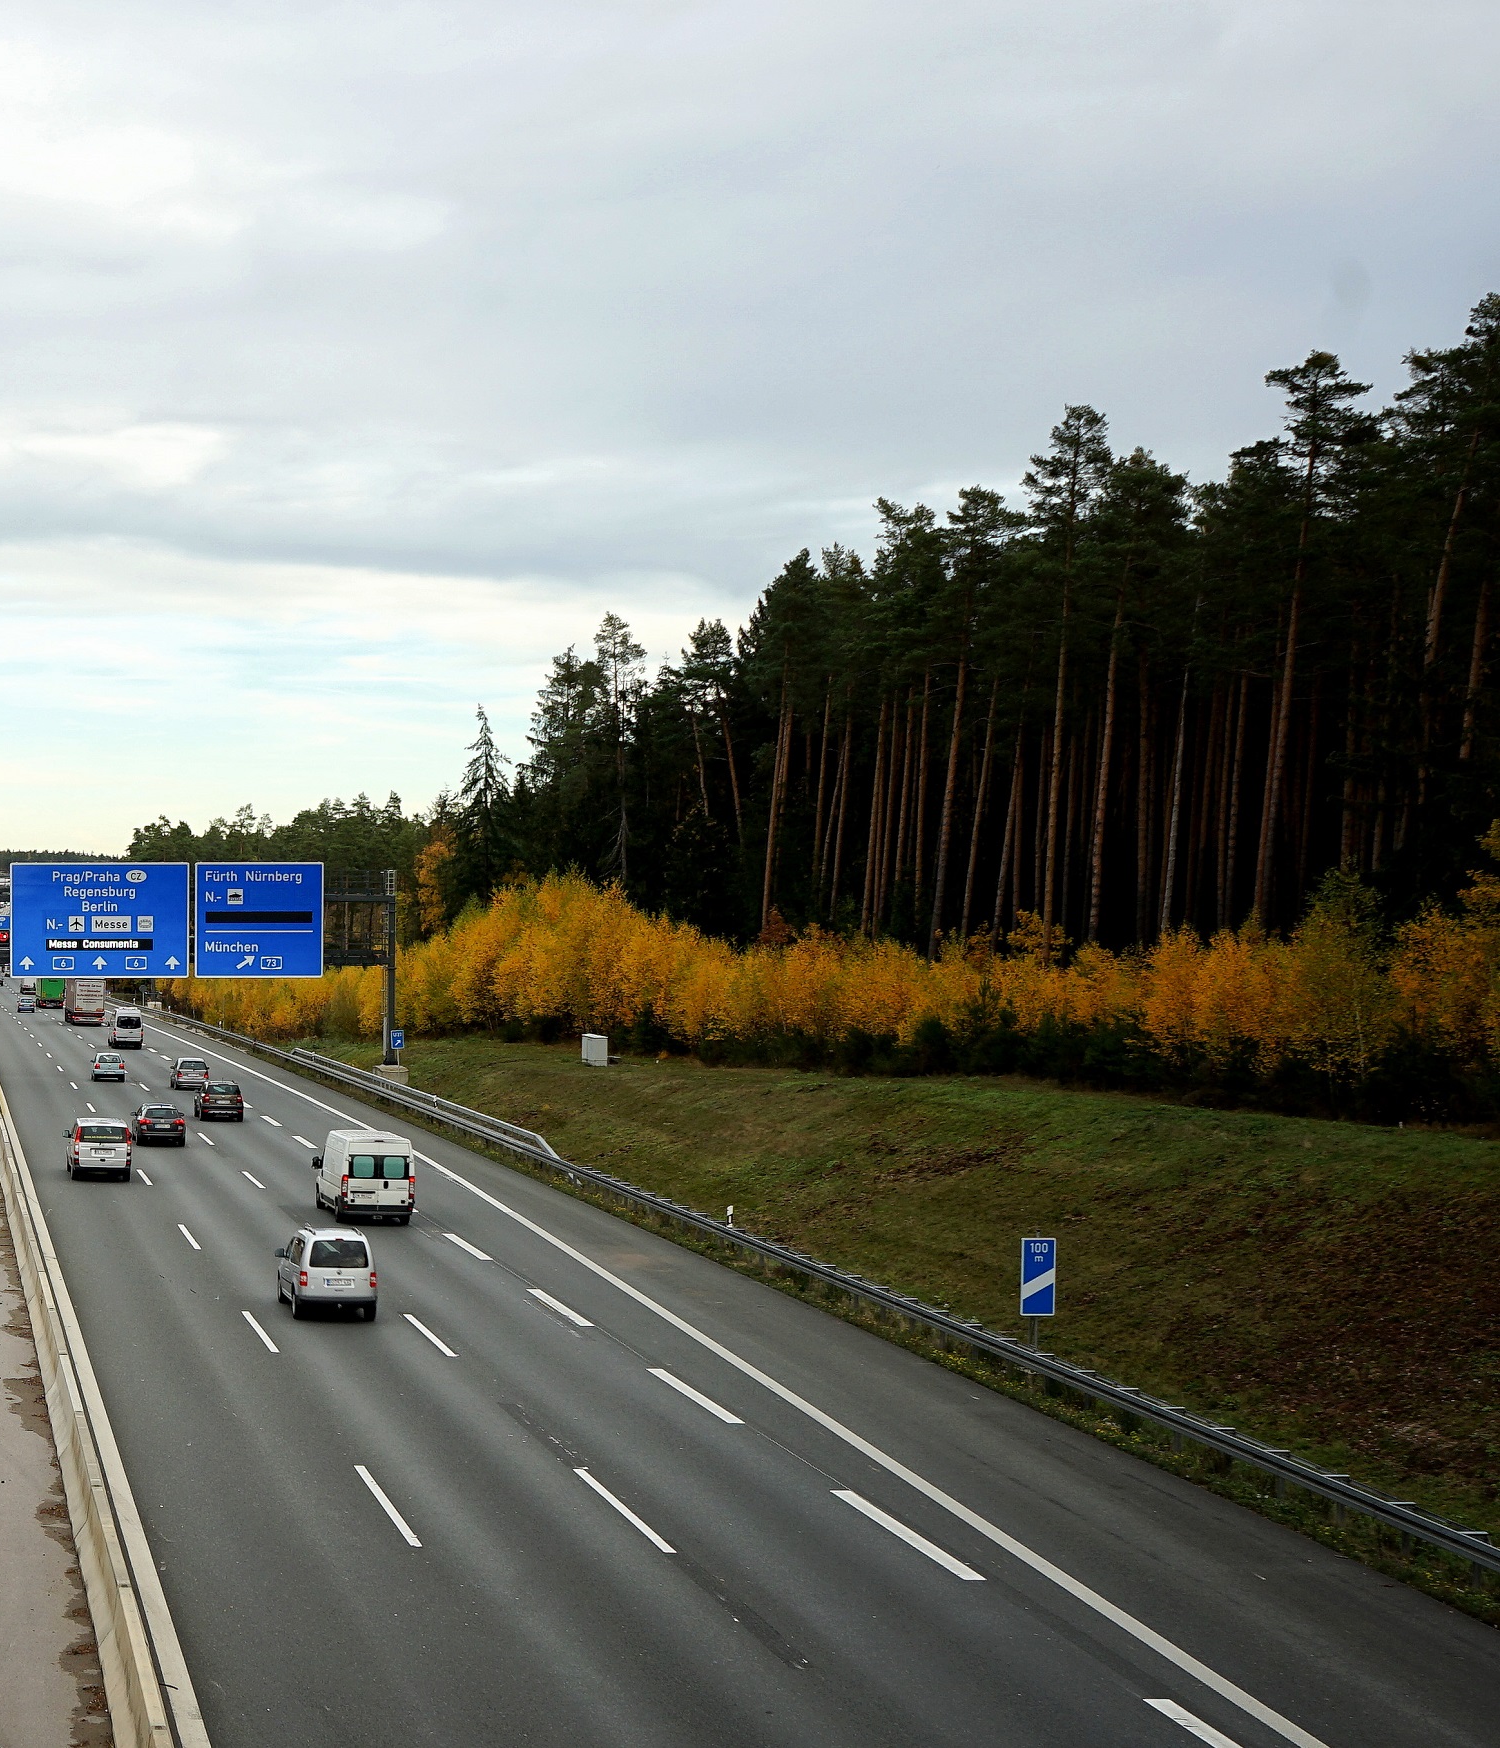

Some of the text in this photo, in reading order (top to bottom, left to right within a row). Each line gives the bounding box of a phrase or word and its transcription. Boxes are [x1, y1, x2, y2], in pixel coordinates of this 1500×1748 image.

[52, 871, 142, 884] Prag/Praha CZ
[205, 870, 303, 884] Fürth Nürnberg
[64, 886, 136, 900] Regensburg
[81, 900, 118, 912] Berlin
[95, 919, 128, 929] Messe
[48, 939, 139, 949] Messe Consumenta
[204, 941, 259, 953] München
[60, 958, 67, 968] 6
[133, 958, 140, 968] 6
[266, 959, 277, 967] 73
[1030, 1242, 1049, 1253] 100
[1034, 1255, 1044, 1263] m
